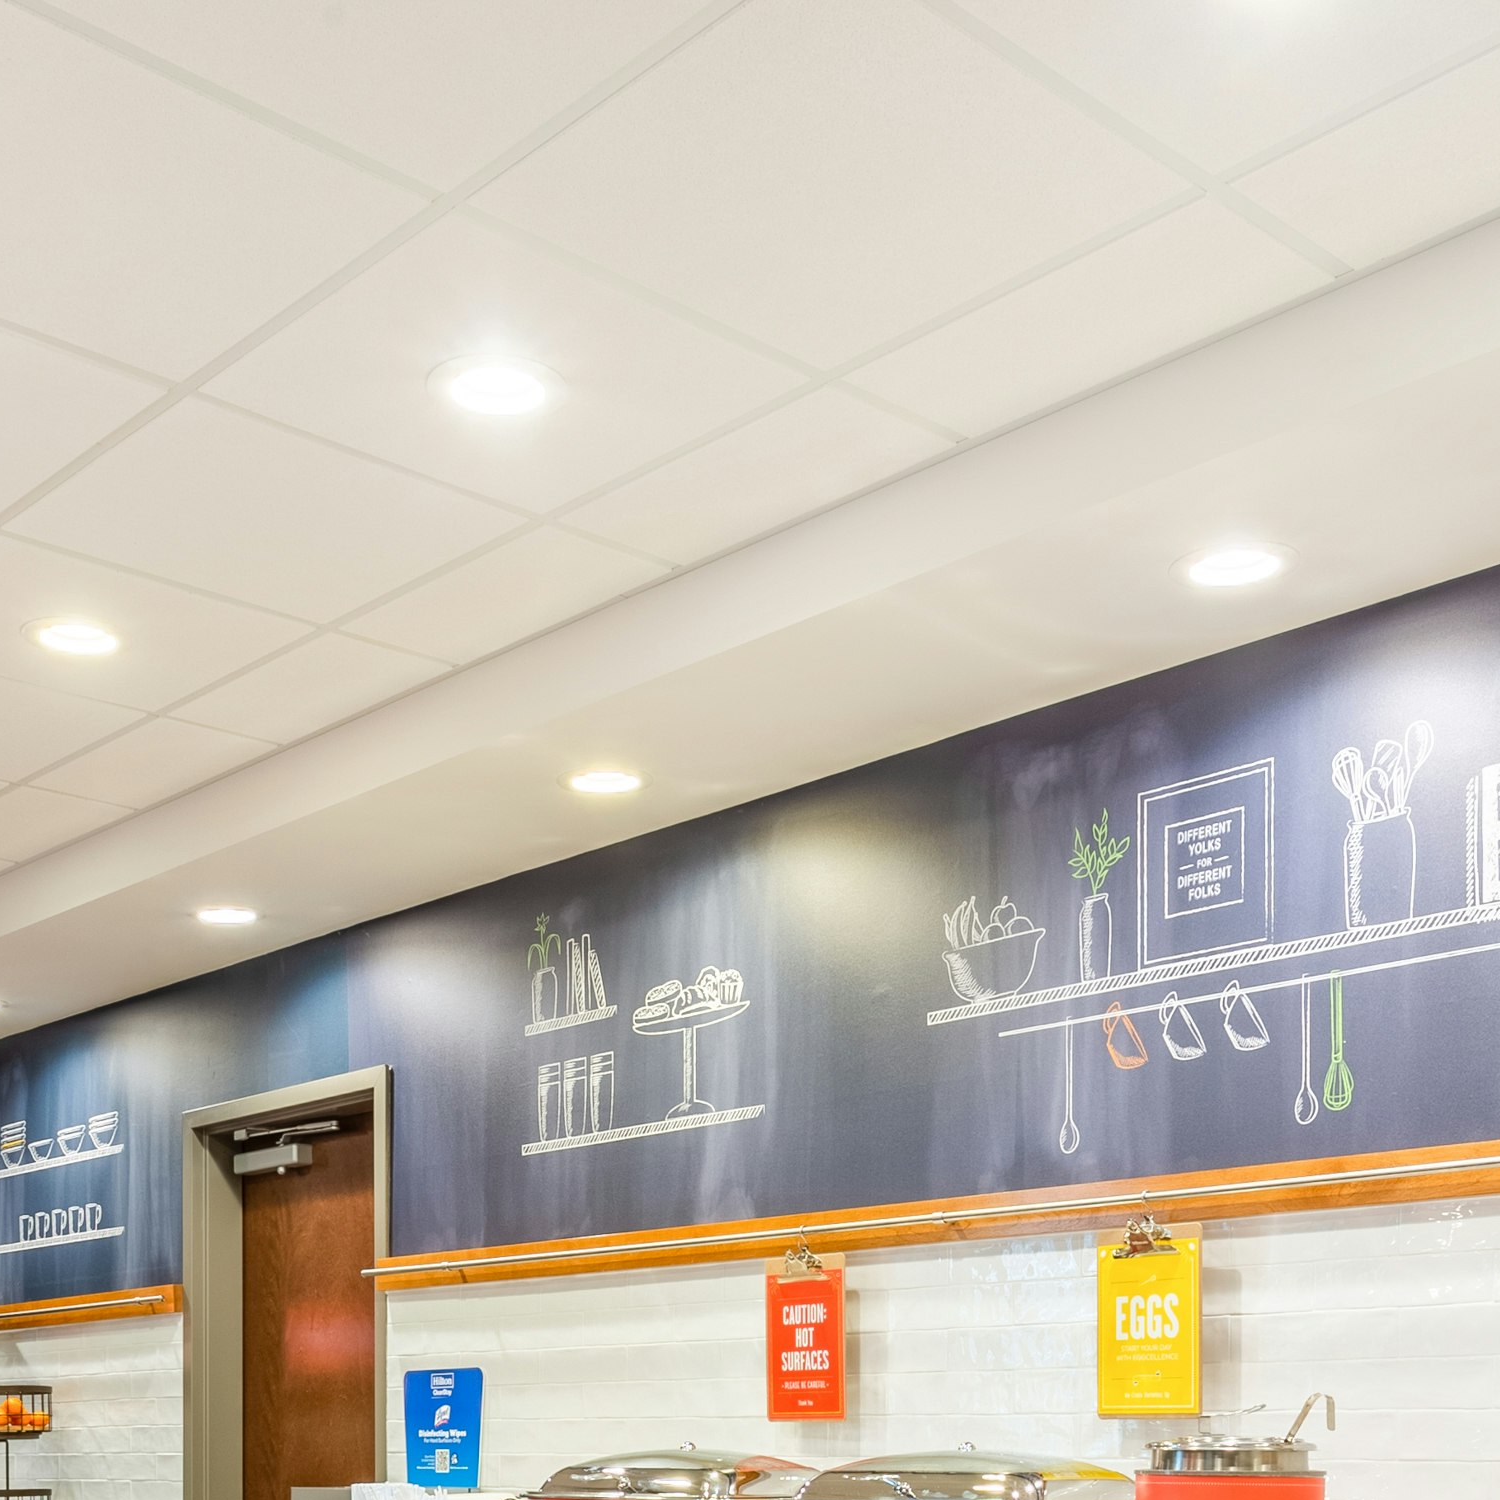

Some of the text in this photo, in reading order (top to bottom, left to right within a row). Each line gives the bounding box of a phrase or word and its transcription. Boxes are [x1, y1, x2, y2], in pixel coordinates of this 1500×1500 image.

[1177, 819, 1232, 845] DIFFERENT
[1189, 838, 1221, 857] YOLKS
[1196, 857, 1212, 869] FOR
[1177, 865, 1232, 889] DIFFERENT
[1188, 884, 1221, 901] FOLKS
[782, 1303, 827, 1325] CAUTION:
[1115, 1293, 1179, 1341] EGGS
[795, 1327, 814, 1348] HOT
[781, 1350, 829, 1371] SURFACES
[433, 1376, 452, 1386] Hilton
[784, 1381, 800, 1389] PLEASE
[807, 1380, 826, 1389] CAREFUL
[418, 1429, 467, 1438] Disinfecting Wipes
